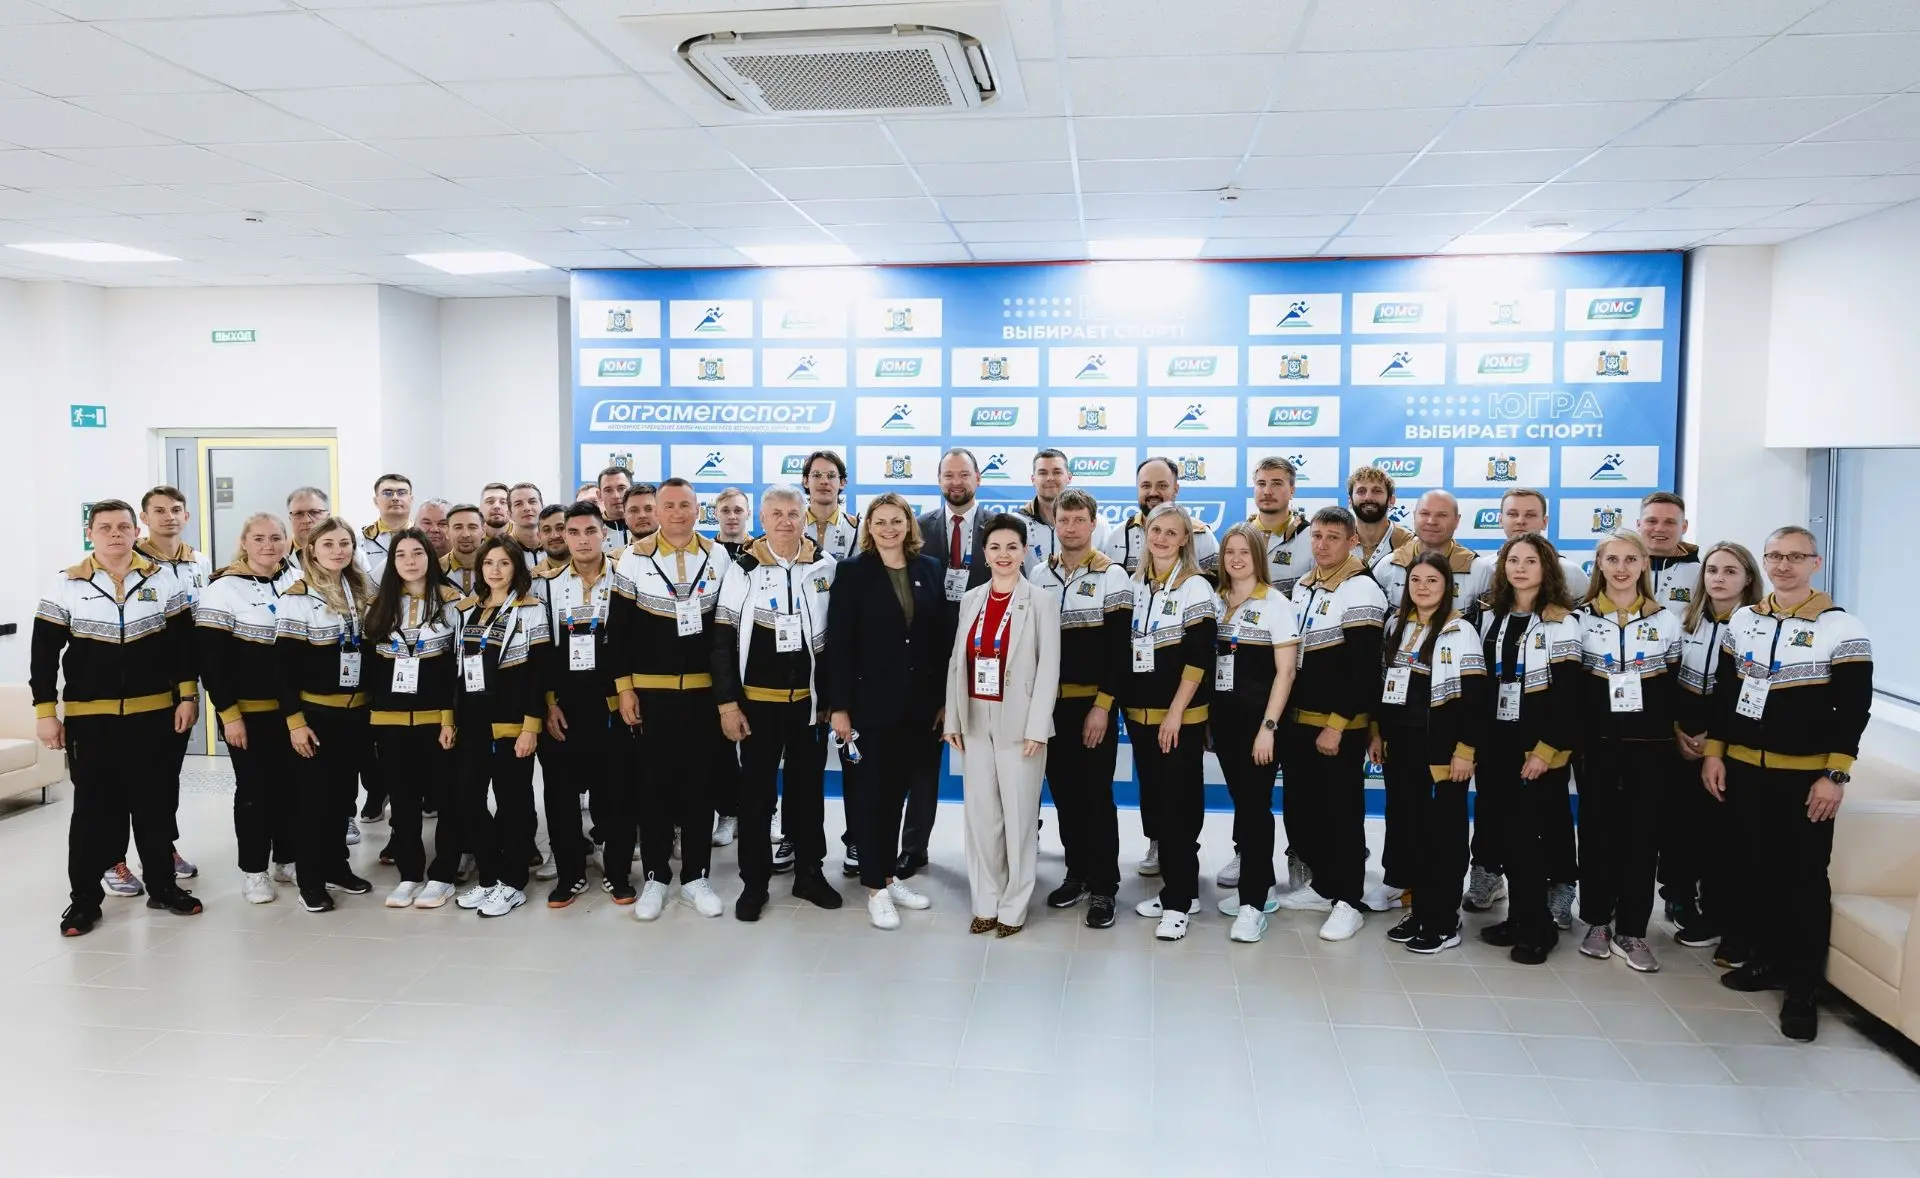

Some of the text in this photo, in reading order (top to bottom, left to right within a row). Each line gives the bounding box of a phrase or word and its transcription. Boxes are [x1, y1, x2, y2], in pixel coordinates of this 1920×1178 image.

[1379, 306, 1418, 318] ЮМС
[1594, 301, 1634, 313] ЮМС
[214, 331, 252, 341] ВЫХОД
[1002, 325, 1109, 340] ВЫБИРАЕТ
[603, 360, 636, 372] ЮМС
[881, 360, 916, 372] ЮМС
[1174, 358, 1211, 371] ЮМС
[1484, 354, 1524, 367] ЮМС
[1488, 391, 1603, 419] ЮГРА
[977, 410, 1012, 421] ЮМС
[1274, 409, 1312, 420] ЮМС
[1405, 423, 1603, 439] ВЫБИРАЕТ СПОРТ!
[1073, 460, 1110, 470] ЮМС
[1377, 459, 1416, 470] ЮМС
